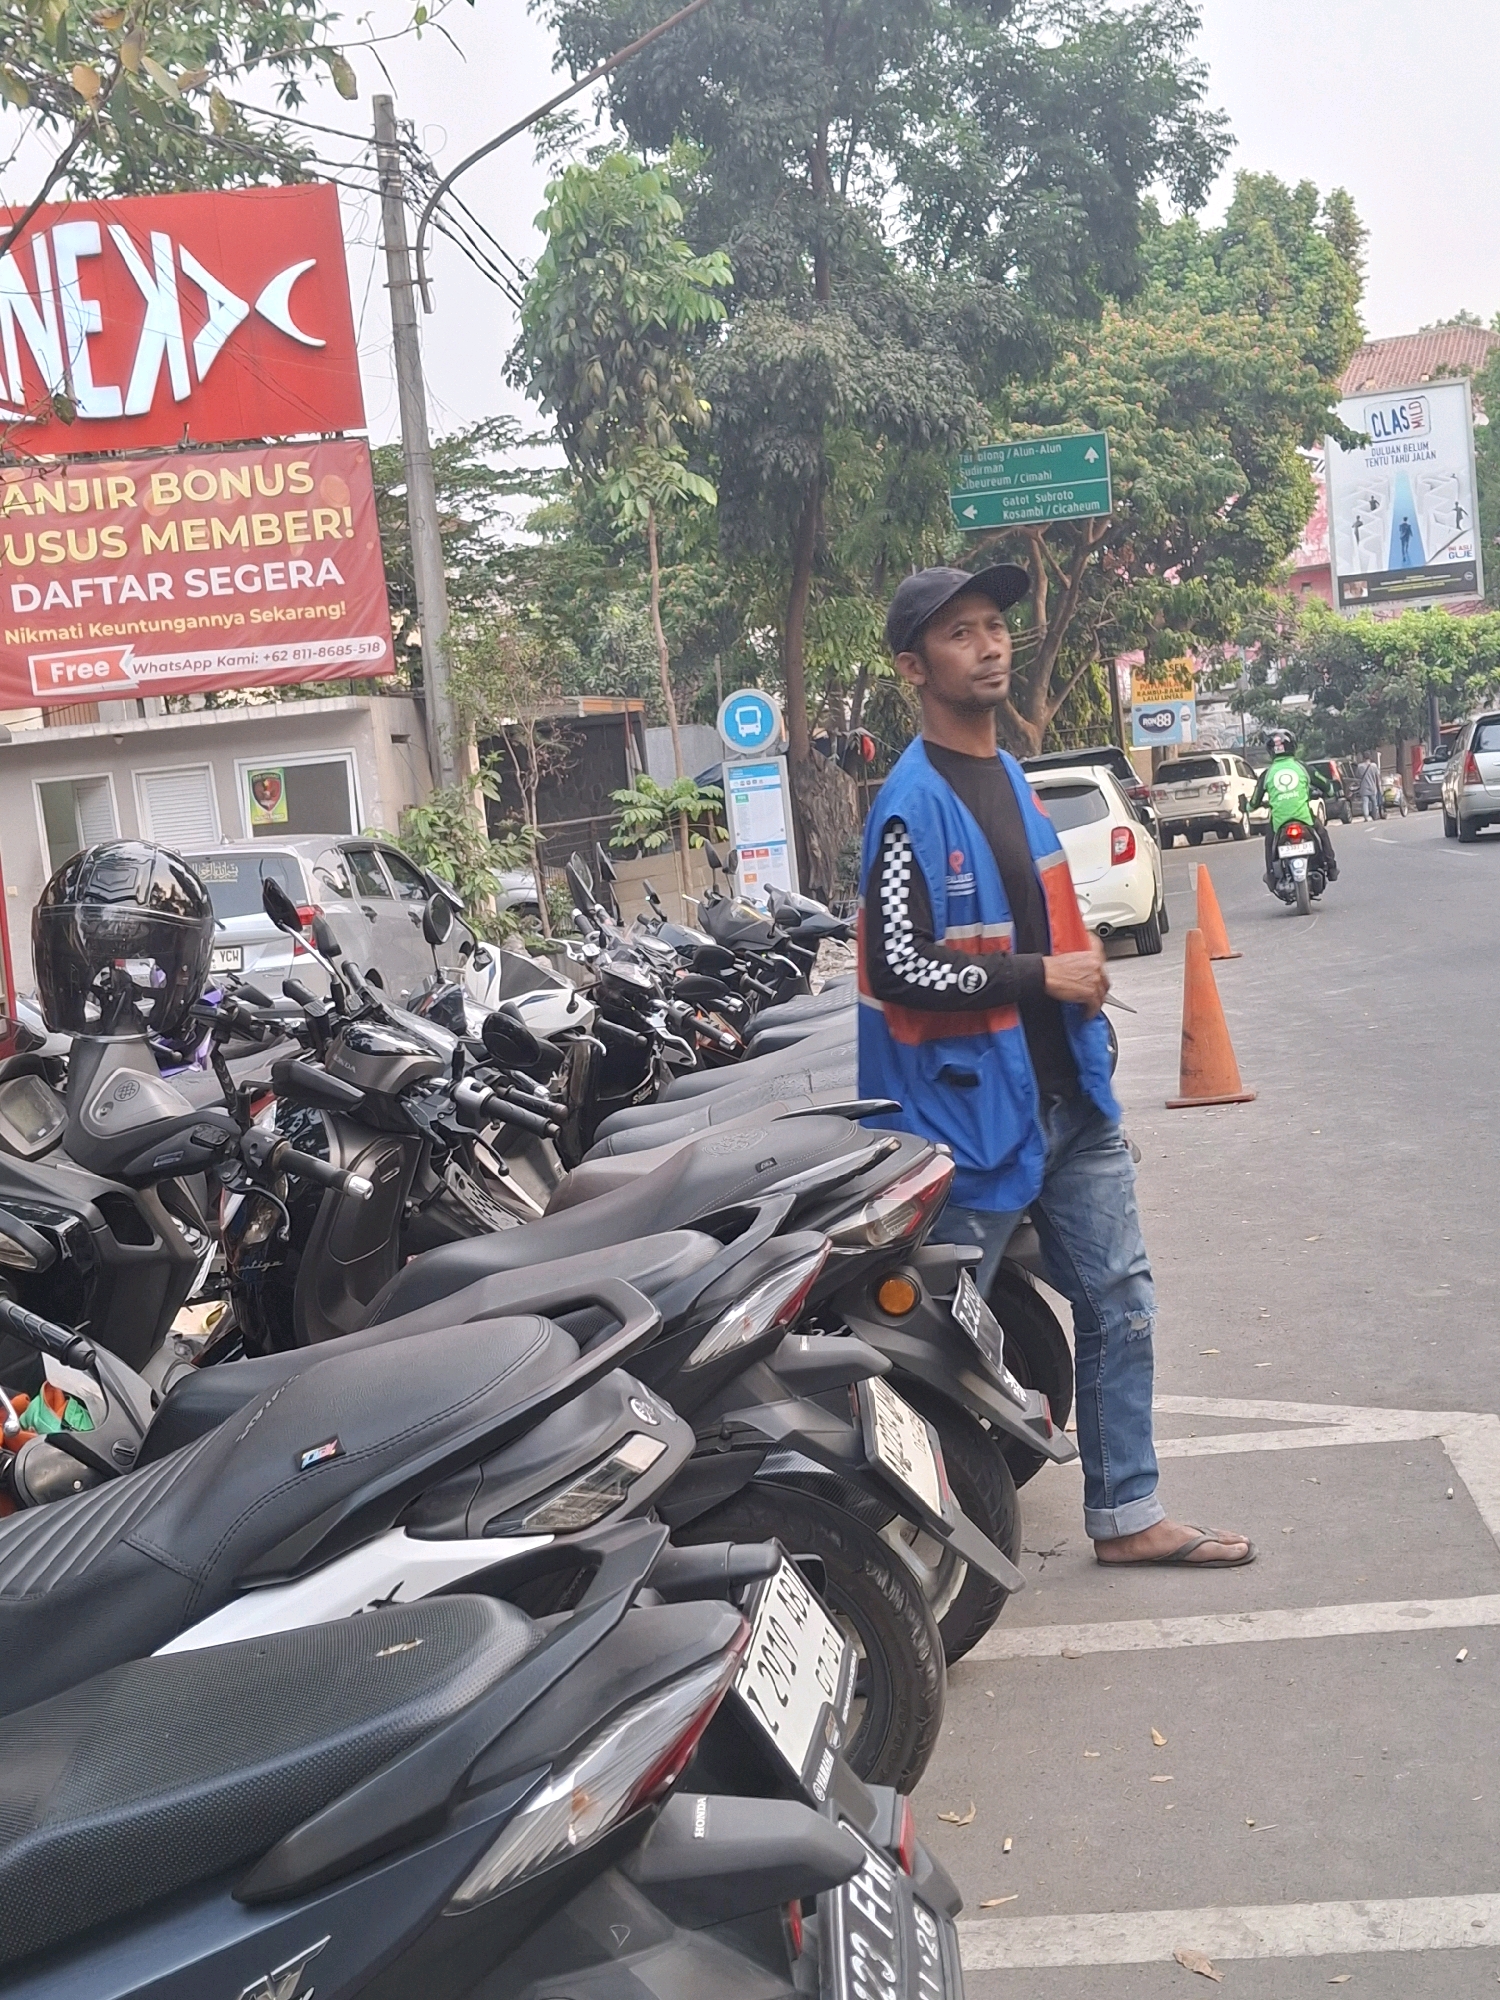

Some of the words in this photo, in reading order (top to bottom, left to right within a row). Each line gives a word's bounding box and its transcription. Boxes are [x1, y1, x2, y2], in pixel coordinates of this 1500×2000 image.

[1371, 405, 1410, 437] CLAS
[1408, 400, 1425, 429] MILD
[1013, 443, 1062, 458] Alun-Alun
[1365, 456, 1388, 468] TENTU
[1390, 453, 1410, 465] TAHU
[1412, 450, 1437, 462] JALAN
[1371, 445, 1400, 457] DULUAN
[1403, 441, 1429, 453] BELUM
[959, 463, 1005, 477] Sudirman
[1020, 470, 1052, 483] Cimahi
[150, 461, 314, 507] BONUS
[1002, 493, 1030, 507] Gatot
[1035, 490, 1074, 503] Subroto
[1002, 505, 1044, 520] Kosambi
[1052, 500, 1100, 515] Cicaheum
[0, 525, 128, 568] USUS
[141, 506, 355, 555] MEMBER!
[1448, 550, 1473, 559] GUE
[10, 572, 175, 613] DAFTAR
[185, 557, 345, 598] SEGERA
[5, 622, 84, 645] Nikmati
[89, 611, 246, 640] Keuntungannya
[249, 600, 347, 626] Sekarang!
[133, 654, 213, 675] WhatsApp
[217, 652, 259, 668] Kami:
[263, 649, 288, 663] +62
[292, 640, 381, 660] 811-8685-518
[50, 657, 111, 684] Free
[219, 950, 239, 962] YCW
[695, 1796, 707, 1838] HONDA
